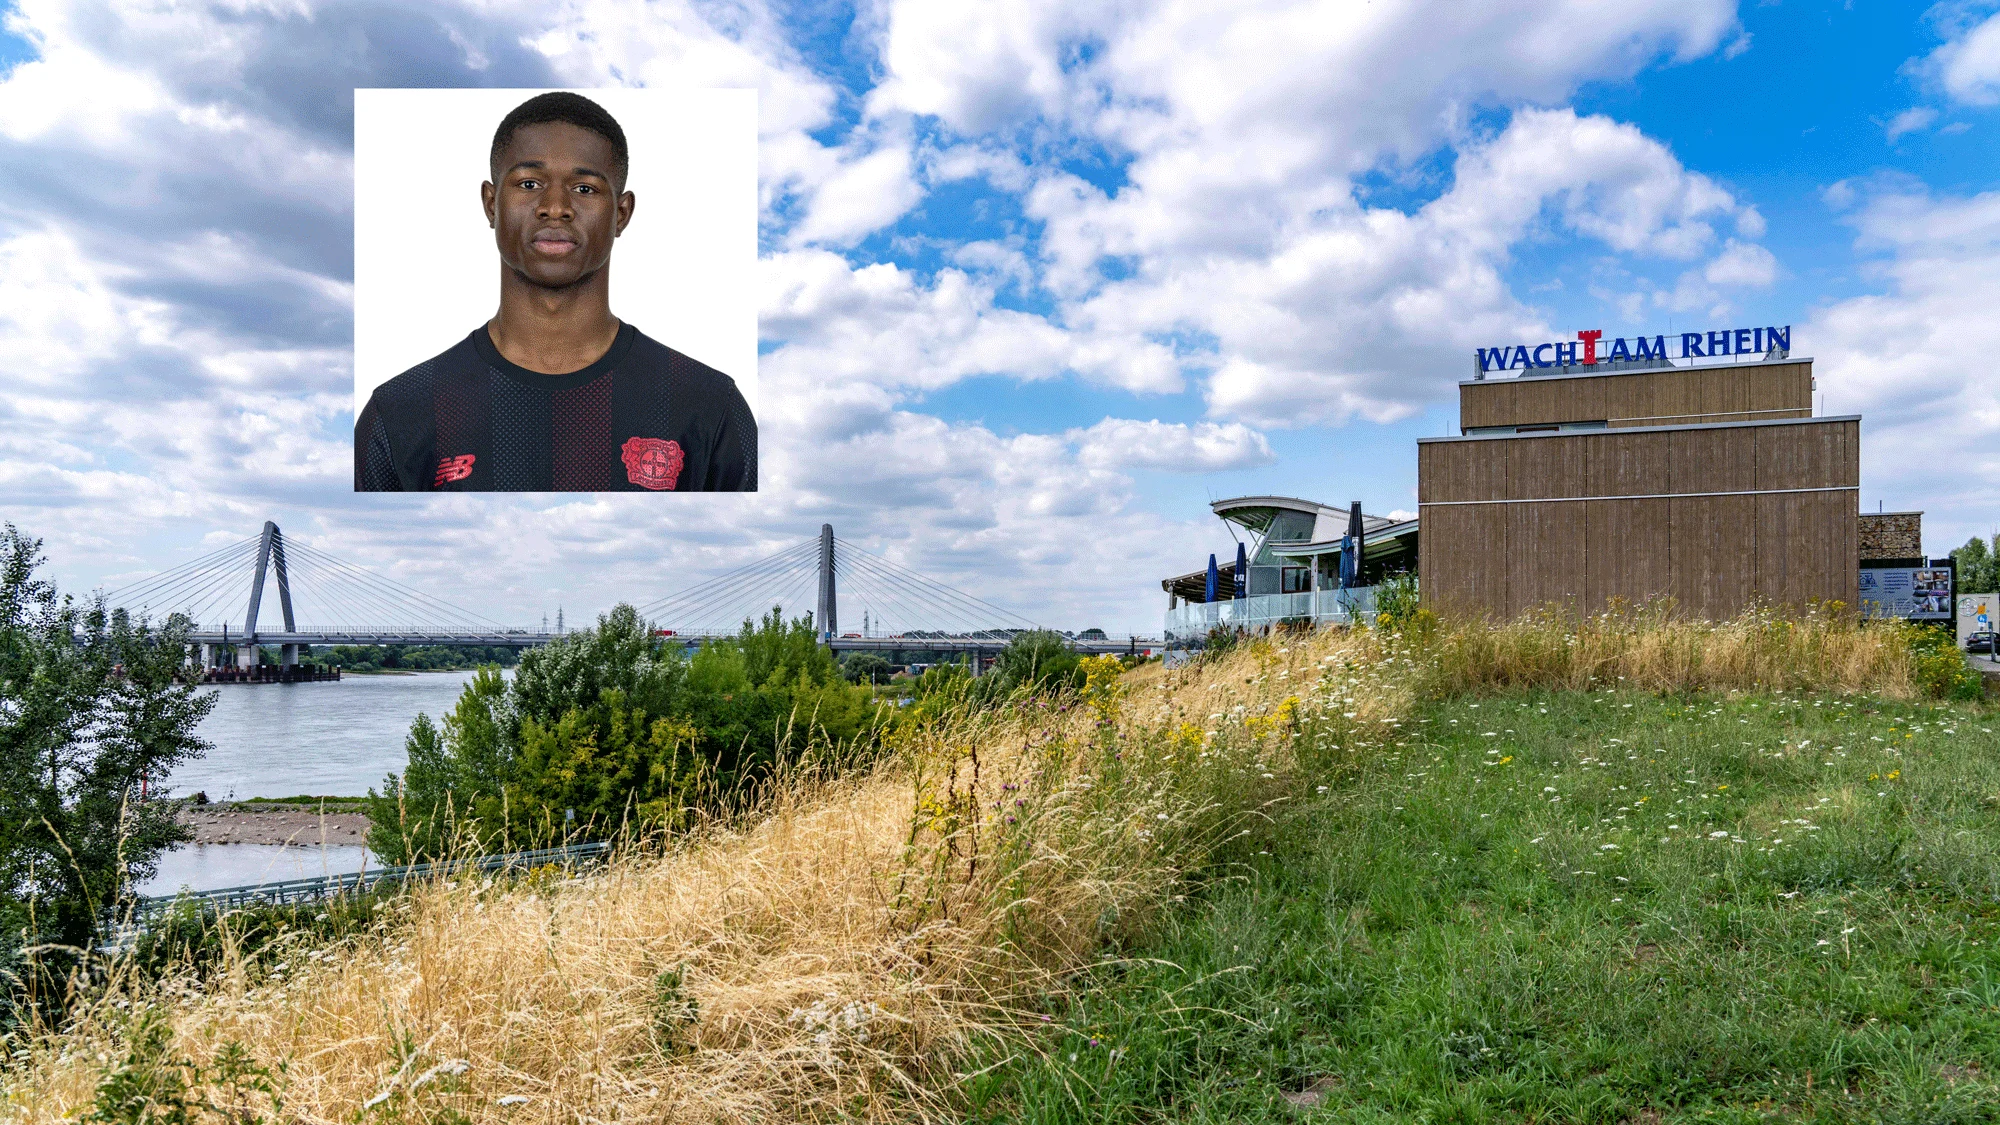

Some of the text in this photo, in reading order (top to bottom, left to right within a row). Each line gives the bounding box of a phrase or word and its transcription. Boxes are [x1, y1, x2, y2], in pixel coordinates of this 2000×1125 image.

[1477, 325, 1791, 372] WACHT AM RHEIN
